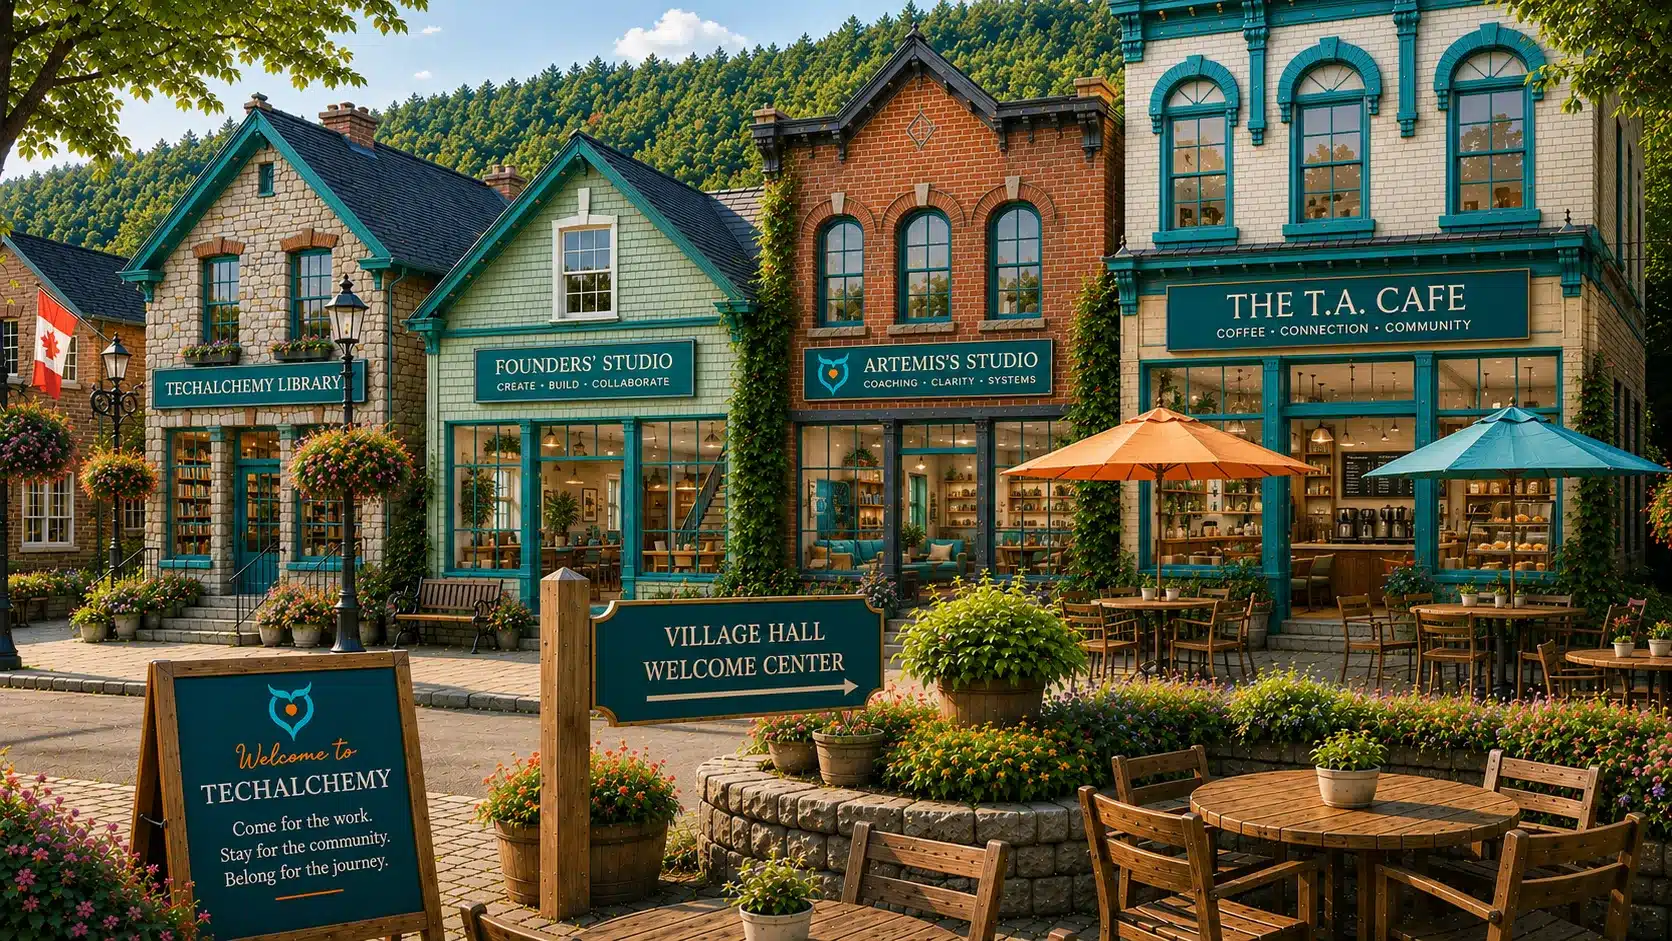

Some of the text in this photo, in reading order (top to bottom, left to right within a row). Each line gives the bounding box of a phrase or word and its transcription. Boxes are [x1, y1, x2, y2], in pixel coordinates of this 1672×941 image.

[1226, 283, 1466, 320] THE T.A. CAFE
[1216, 319, 1472, 339] COFFEE CONNECTION COMMUNITY
[602, 352, 673, 371] STUDIO
[966, 351, 1039, 370] STUDIO
[164, 374, 343, 396] TECHALCHEMY LIBRARY
[496, 376, 670, 392] CREATE BUILD COLLABORATE
[863, 375, 1036, 389] COACHING CLARITY SYSTEMS
[663, 621, 826, 647] VILLAGE HALL
[642, 652, 846, 682] WELCOME CENTER
[235, 737, 358, 770] Welcome to
[200, 768, 392, 805] TECHALCHEMY
[232, 807, 373, 837] Come for the work.
[220, 830, 391, 865] Stay for the community.
[224, 856, 389, 888] Belong for the journey.
